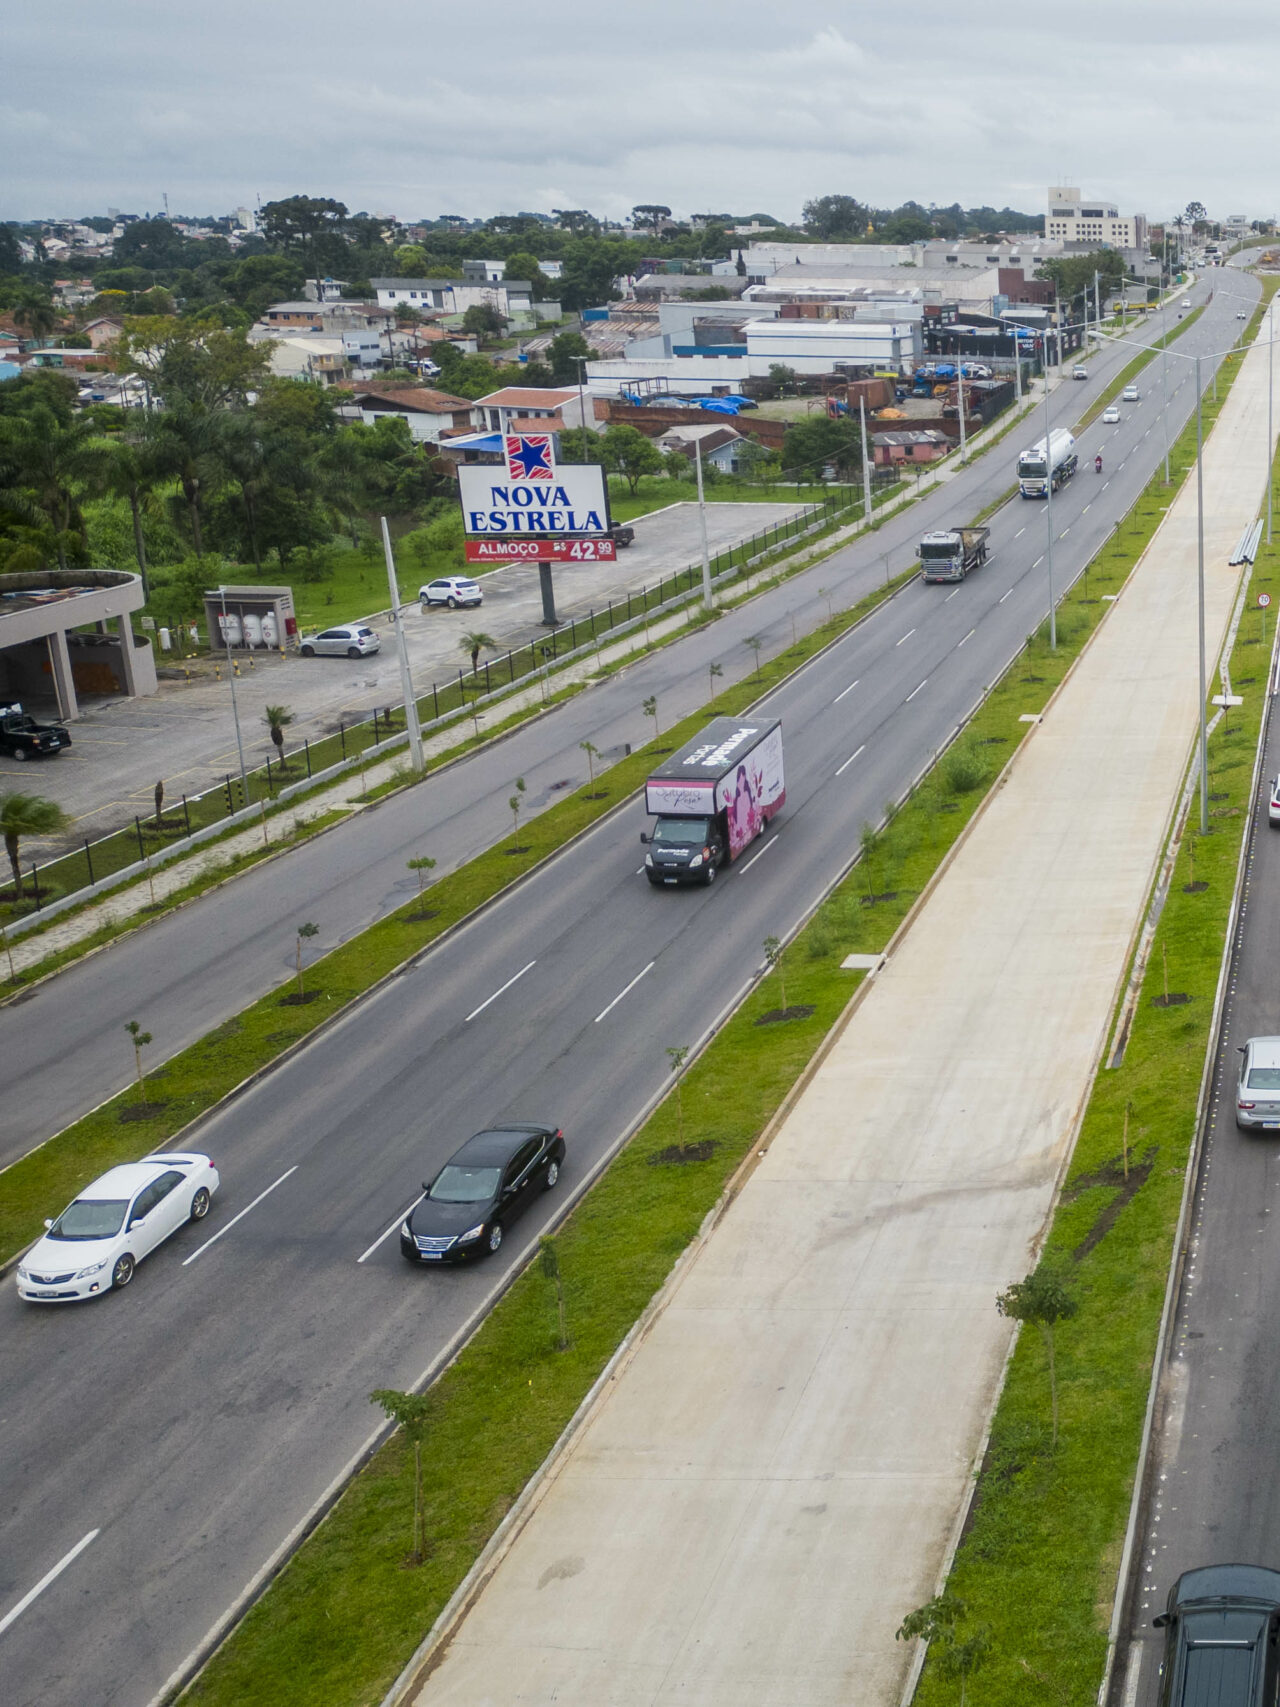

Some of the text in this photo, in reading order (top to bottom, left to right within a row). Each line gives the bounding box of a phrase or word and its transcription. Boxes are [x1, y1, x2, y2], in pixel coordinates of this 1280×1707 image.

[490, 486, 572, 507] NOVA
[469, 511, 604, 531] ESTRELA
[478, 543, 539, 556] ALMOÇO
